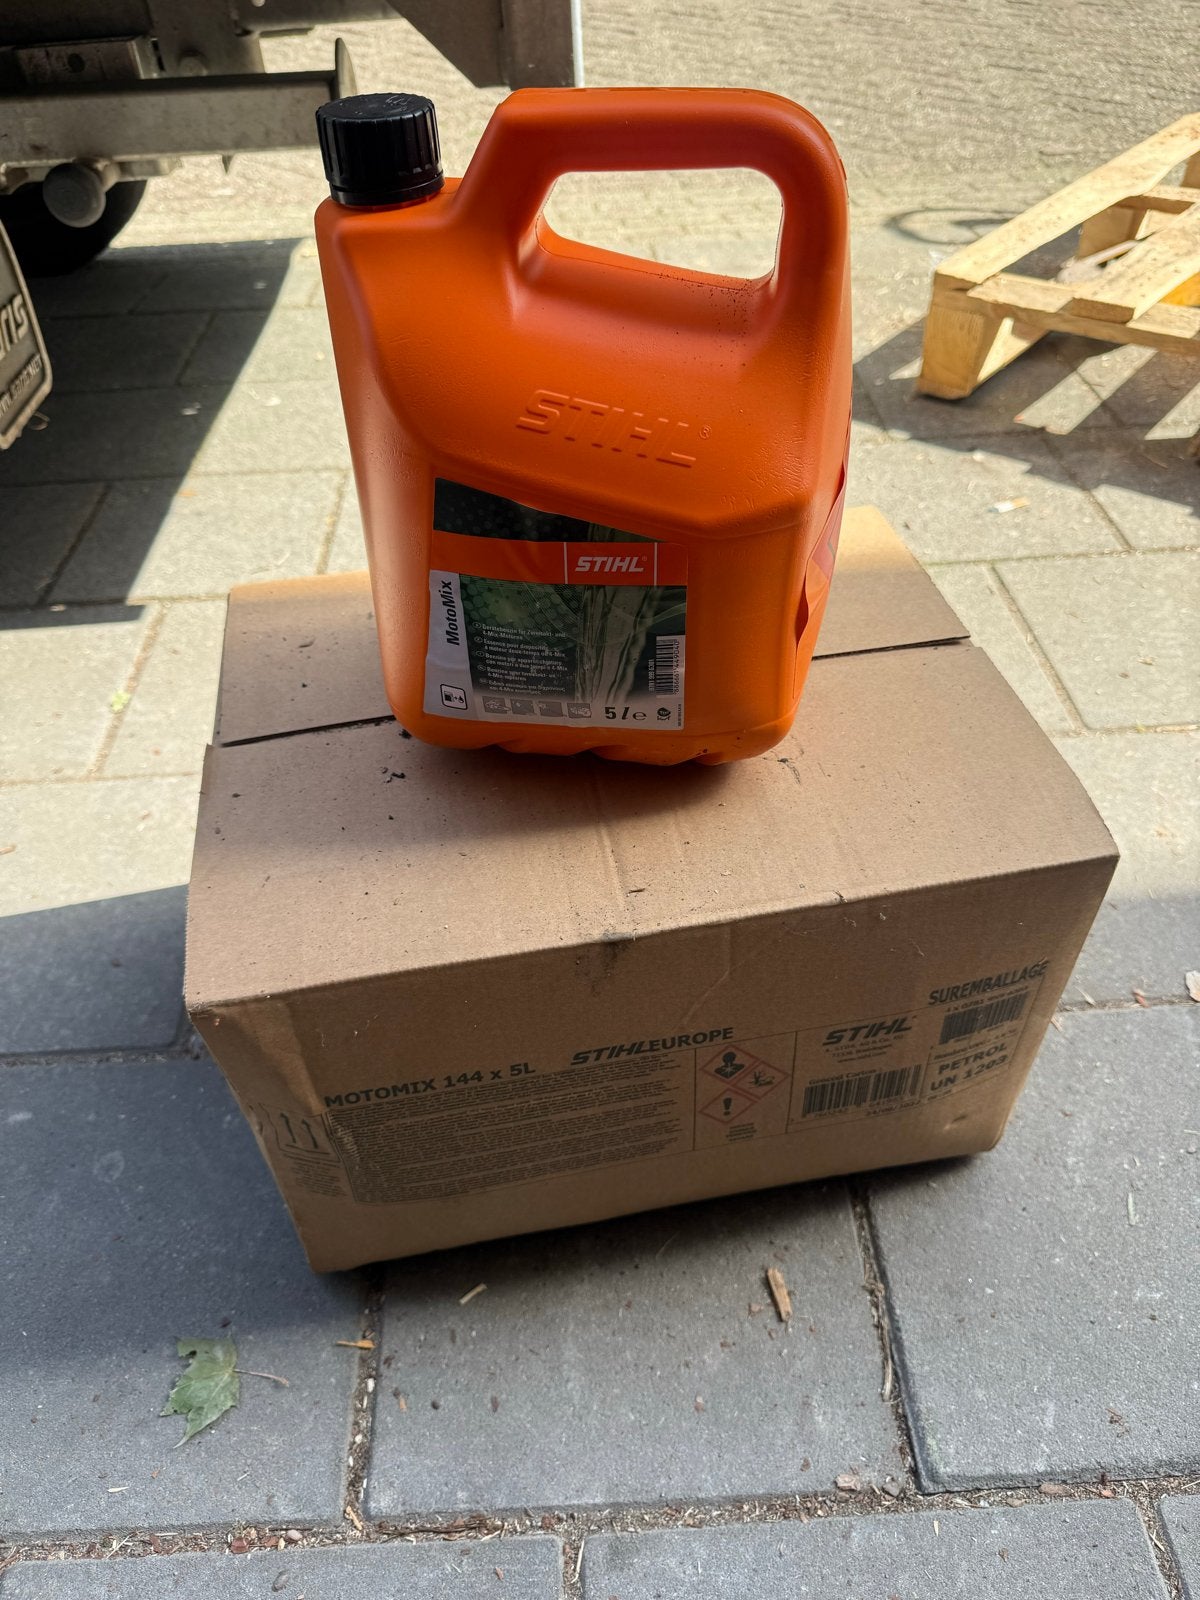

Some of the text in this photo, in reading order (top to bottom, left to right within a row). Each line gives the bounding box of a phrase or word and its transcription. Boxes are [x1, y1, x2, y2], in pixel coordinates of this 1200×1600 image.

[515, 388, 697, 468] STIHL
[574, 556, 645, 573] STIHL
[438, 580, 460, 646] MotoMix
[928, 961, 1050, 1006] SUREMBALLAGE
[822, 1016, 913, 1046] STIHL
[930, 1054, 1008, 1091] UN 1203
[938, 1043, 1008, 1075] PETROL
[324, 1062, 536, 1108] MOTOMIX 144 x 5L
